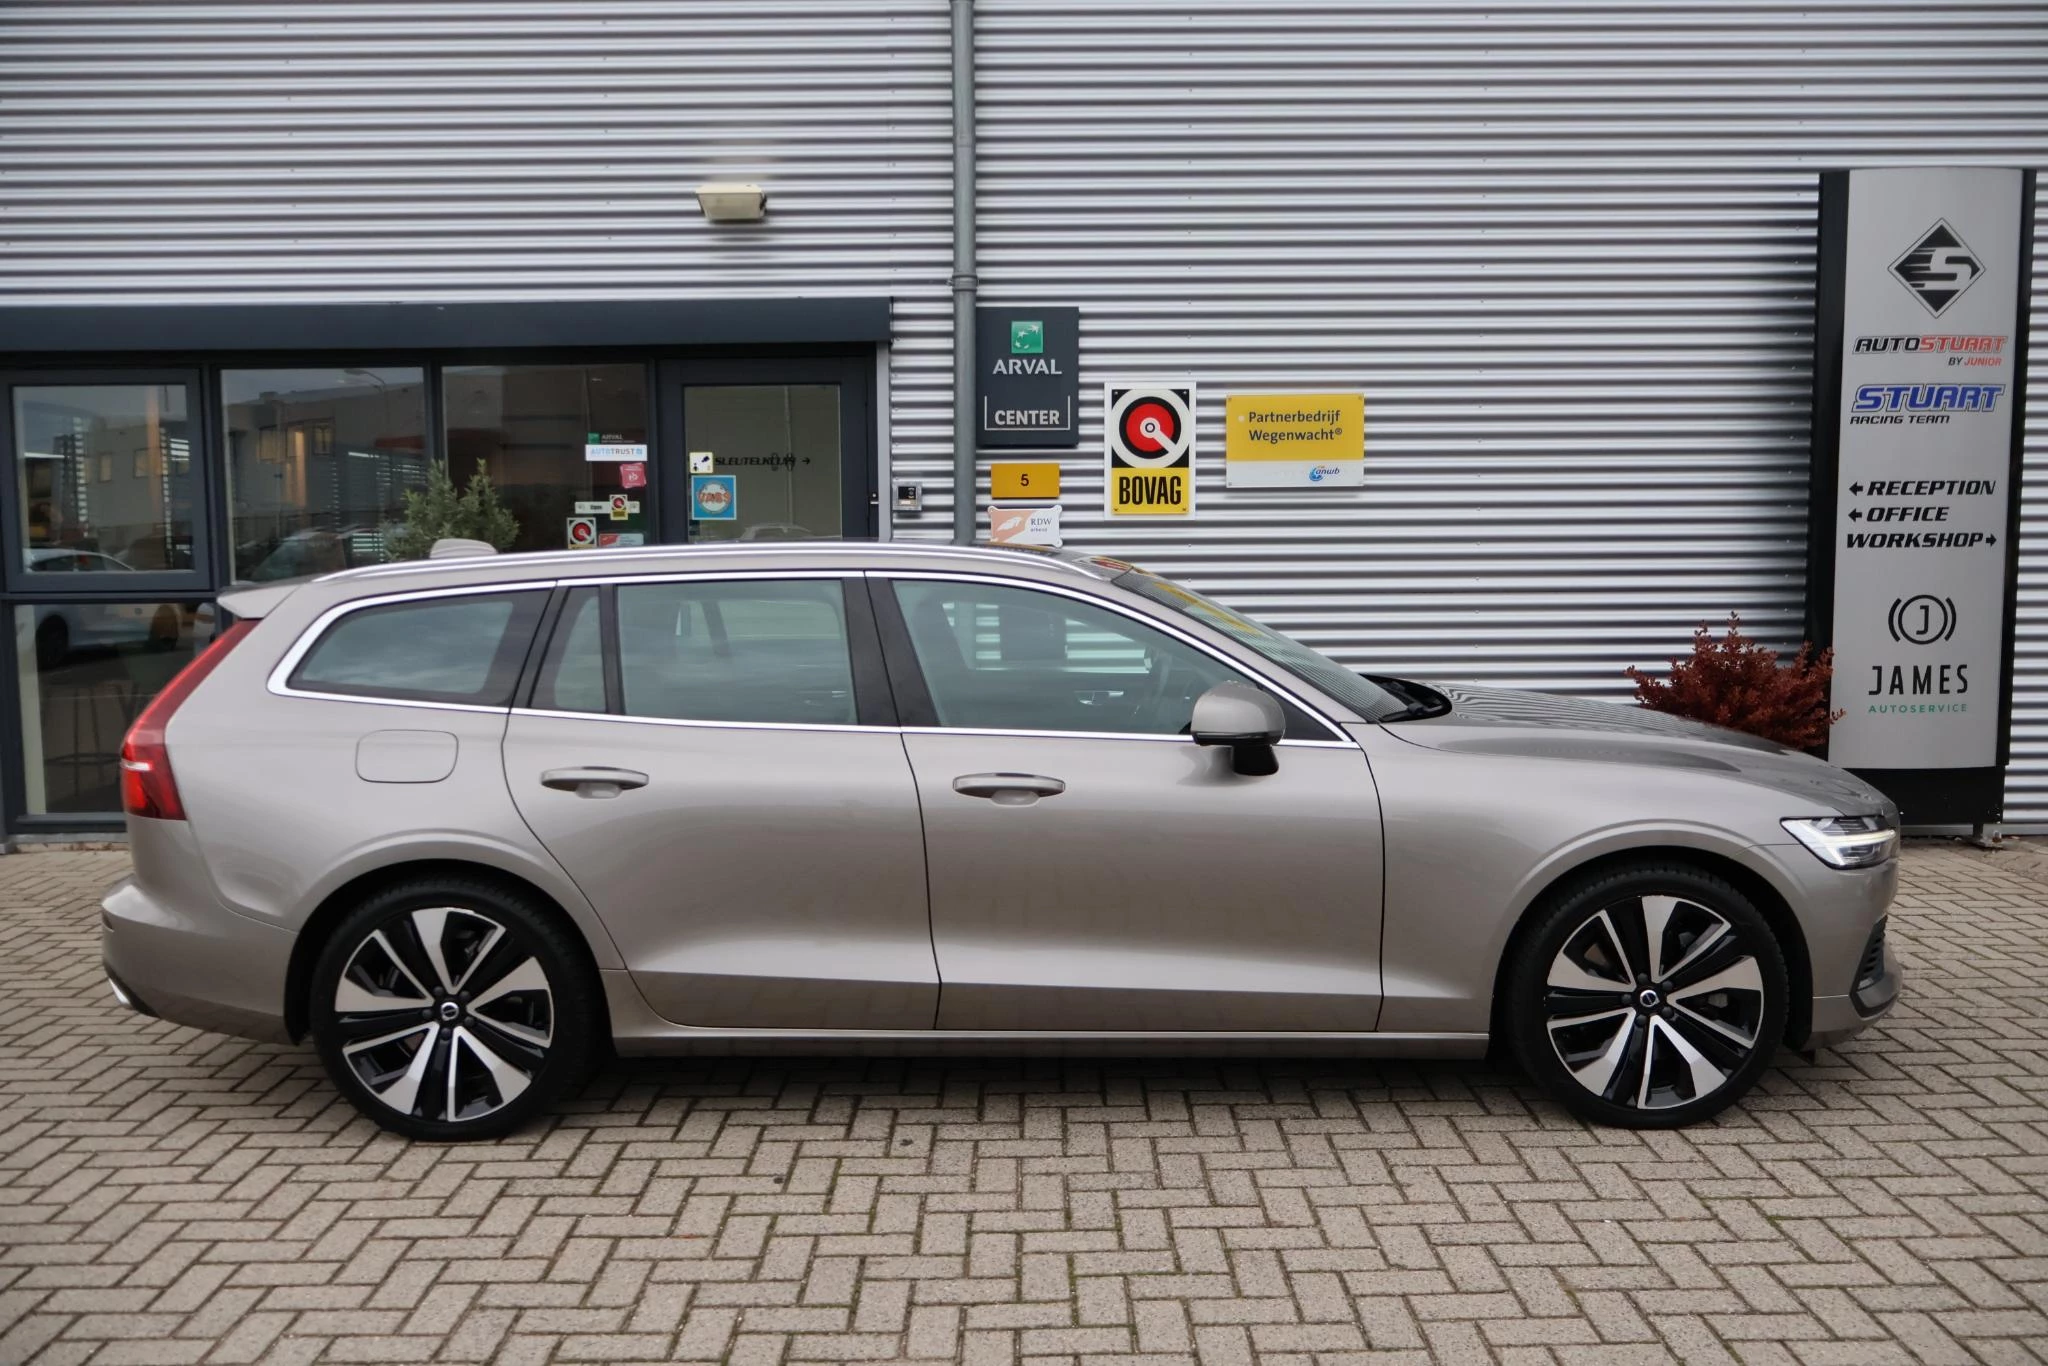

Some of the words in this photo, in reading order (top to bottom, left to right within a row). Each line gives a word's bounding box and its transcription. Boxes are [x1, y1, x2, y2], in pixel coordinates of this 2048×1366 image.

[1854, 336, 2006, 353] AUTOSTUART
[992, 358, 1063, 375] ARVAL
[1948, 357, 1963, 366] BY
[1964, 357, 2002, 367] JUNIOR
[1853, 385, 2004, 411] STUART
[994, 409, 1061, 426] CENTER
[1248, 410, 1341, 426] Partnerbedrijf
[1849, 414, 1903, 425] RACING
[1908, 414, 1950, 424] TEAM
[1020, 473, 1030, 487] 5
[1866, 480, 1997, 496] RECEPTION
[1118, 475, 1182, 506] BOVAG
[1030, 518, 1053, 526] RDW
[1866, 506, 1950, 522] OFFICE
[1846, 532, 1984, 548] WORKSHOP
[1868, 664, 1968, 696] JAMES
[1868, 703, 1967, 714] AUTOSERVICE
